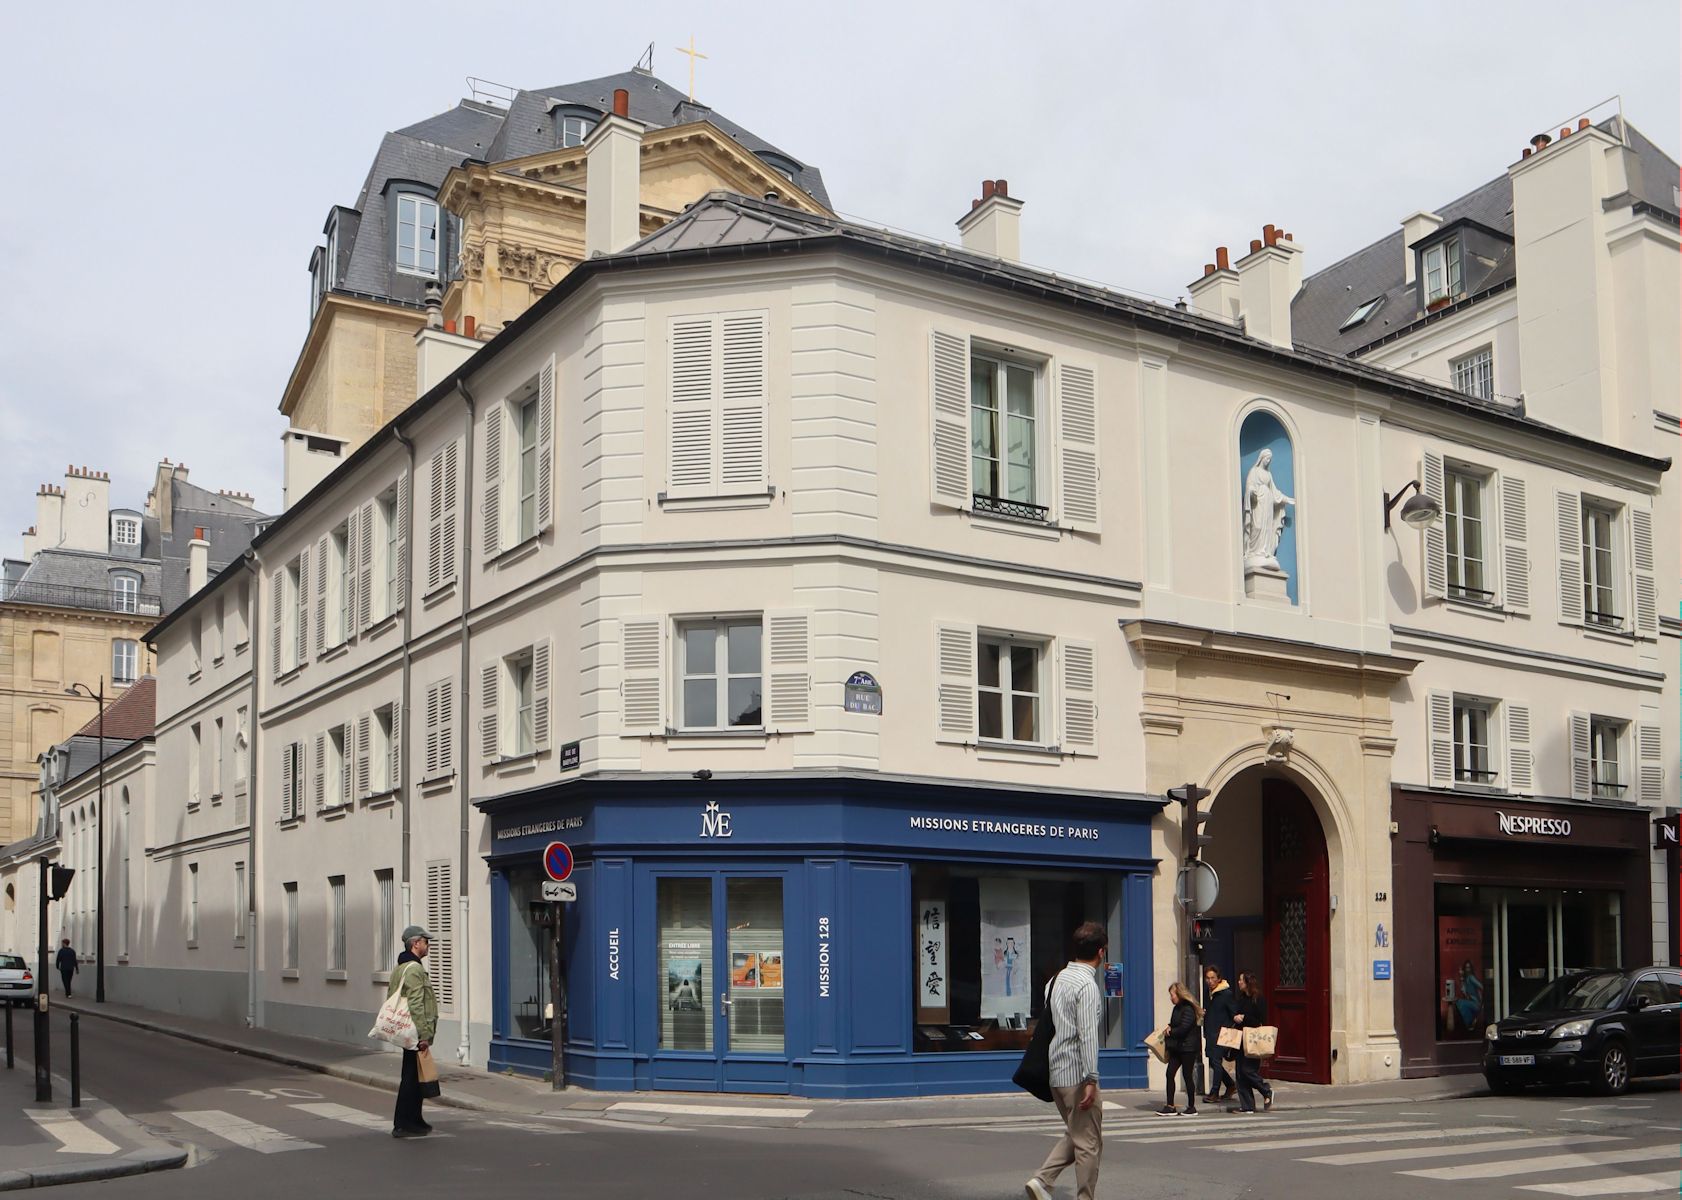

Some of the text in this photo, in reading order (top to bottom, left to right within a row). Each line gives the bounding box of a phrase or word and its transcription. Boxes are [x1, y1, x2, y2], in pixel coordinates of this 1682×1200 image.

[850, 702, 860, 710] DU
[856, 693, 870, 702] RUE
[497, 816, 583, 840] MISSIONS ETRANGERES DE PARIS
[910, 816, 1099, 840] MISSIONS ETRANGERES DE PARIS
[609, 927, 619, 980] ACCUEIL
[819, 917, 830, 997] MISSION 128
[225, 1088, 325, 1100] 30
